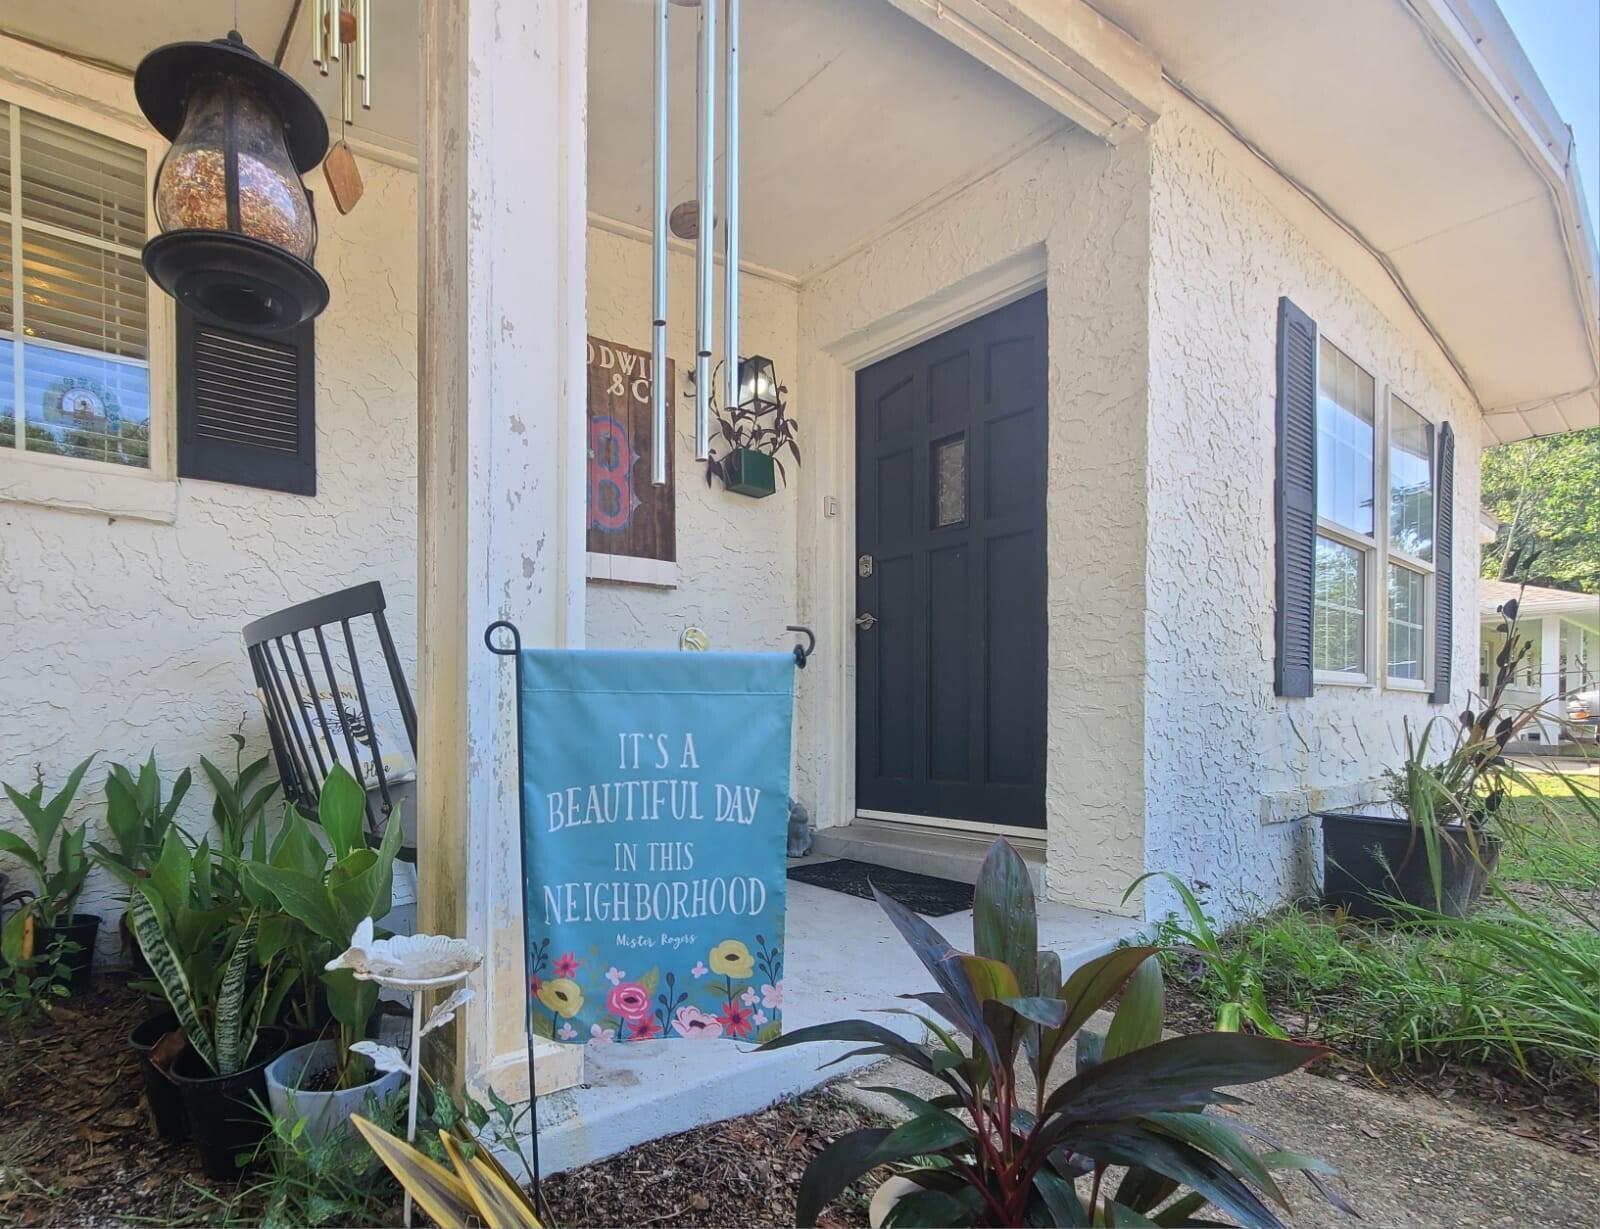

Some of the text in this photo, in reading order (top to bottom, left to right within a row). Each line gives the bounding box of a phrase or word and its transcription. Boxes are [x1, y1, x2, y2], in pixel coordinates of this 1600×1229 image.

[587, 341, 653, 381] DWI
[606, 373, 653, 404] & C
[618, 732, 700, 770] IT'S A
[547, 780, 761, 833] BEAUTIFUL DAY
[613, 841, 694, 872] IN THIS
[543, 876, 767, 926] NEIGHBORHOOD
[615, 932, 699, 951] Mister Rogers
